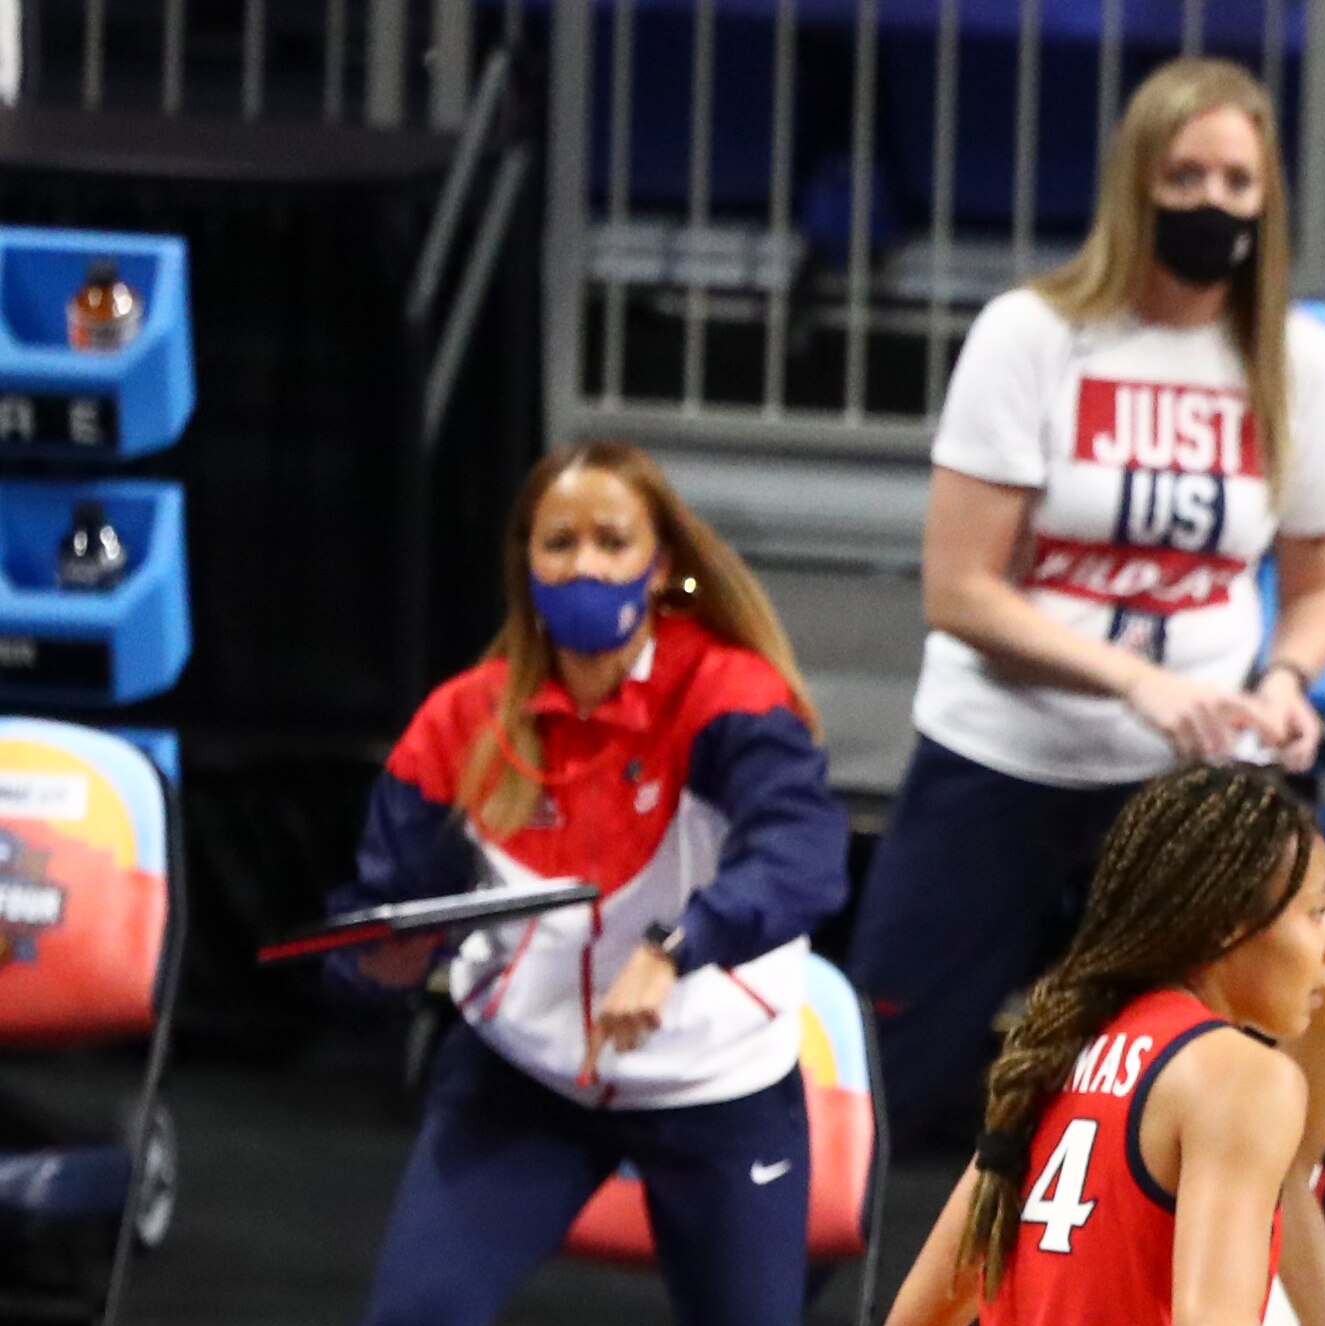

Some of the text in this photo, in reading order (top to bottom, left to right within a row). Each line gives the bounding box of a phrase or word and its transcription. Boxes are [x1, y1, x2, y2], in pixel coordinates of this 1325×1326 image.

[1091, 384, 1243, 474] JUST
[1126, 470, 1216, 551] US
[1063, 1032, 1154, 1098] MAS
[1020, 1117, 1099, 1254] 4
